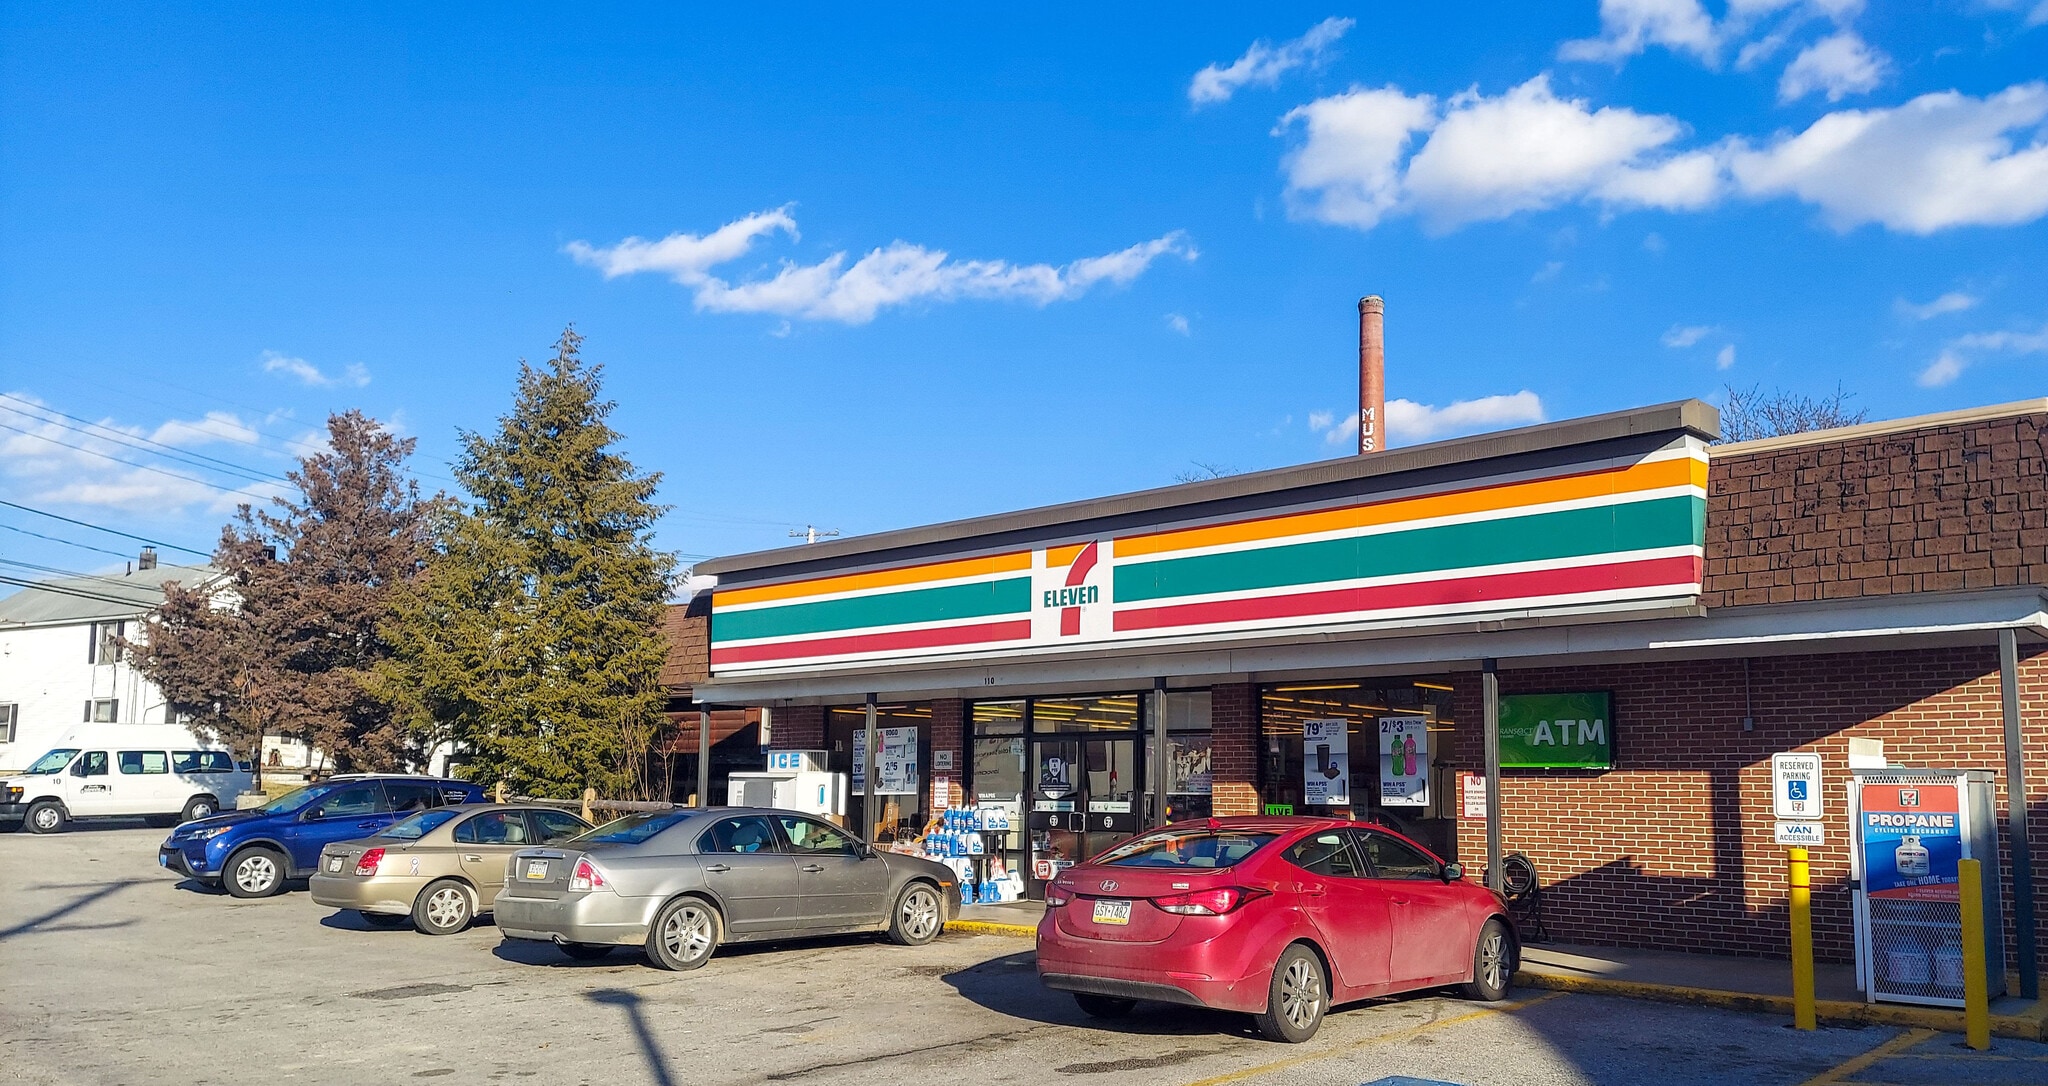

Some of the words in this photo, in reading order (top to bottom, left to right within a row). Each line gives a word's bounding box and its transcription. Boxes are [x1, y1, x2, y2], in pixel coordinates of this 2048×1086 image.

[1060, 538, 1098, 636] 7
[984, 677, 995, 685] 110
[1381, 720, 1404, 733] 2/$3
[1533, 719, 1606, 746] ATM
[771, 753, 800, 768] ICE
[1780, 762, 1813, 770] RESERVED
[1783, 772, 1811, 780] PARKING
[1470, 777, 1482, 786] NO
[1868, 814, 1954, 828] PROPANE
[1786, 826, 1812, 834] VAN
[1780, 834, 1820, 842] ACCESSIBLE
[1918, 875, 1941, 885] HOME
